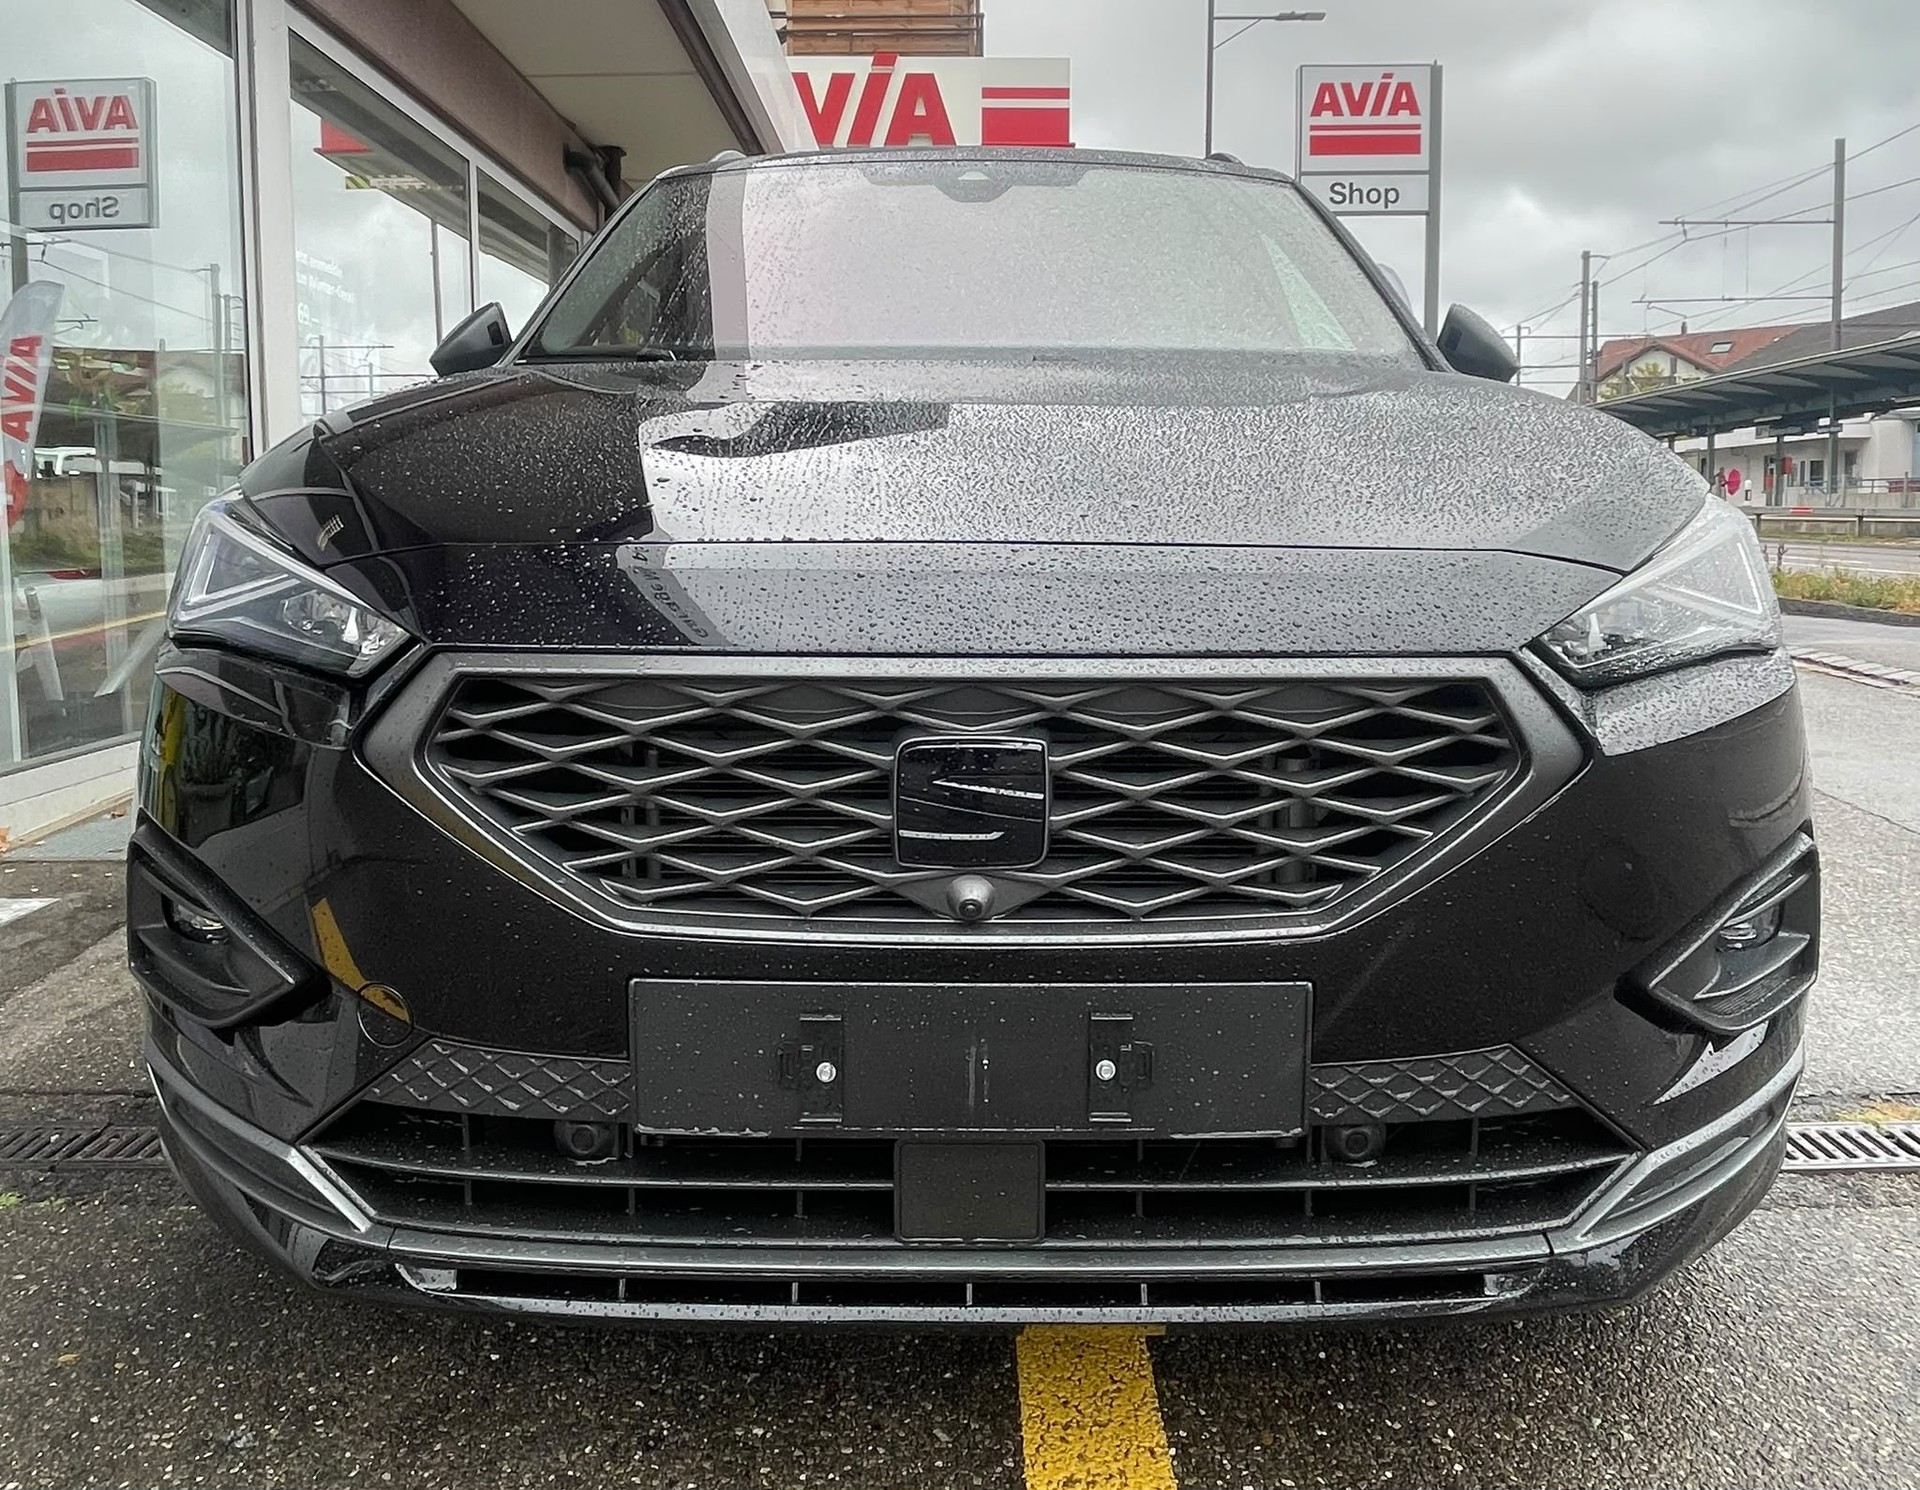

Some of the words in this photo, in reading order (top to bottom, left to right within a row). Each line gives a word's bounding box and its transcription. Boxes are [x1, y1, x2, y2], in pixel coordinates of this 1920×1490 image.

[792, 51, 957, 148] VIA
[1310, 73, 1421, 117] AVIA
[1329, 182, 1400, 209] Shop
[2, 335, 44, 443] AVIA
